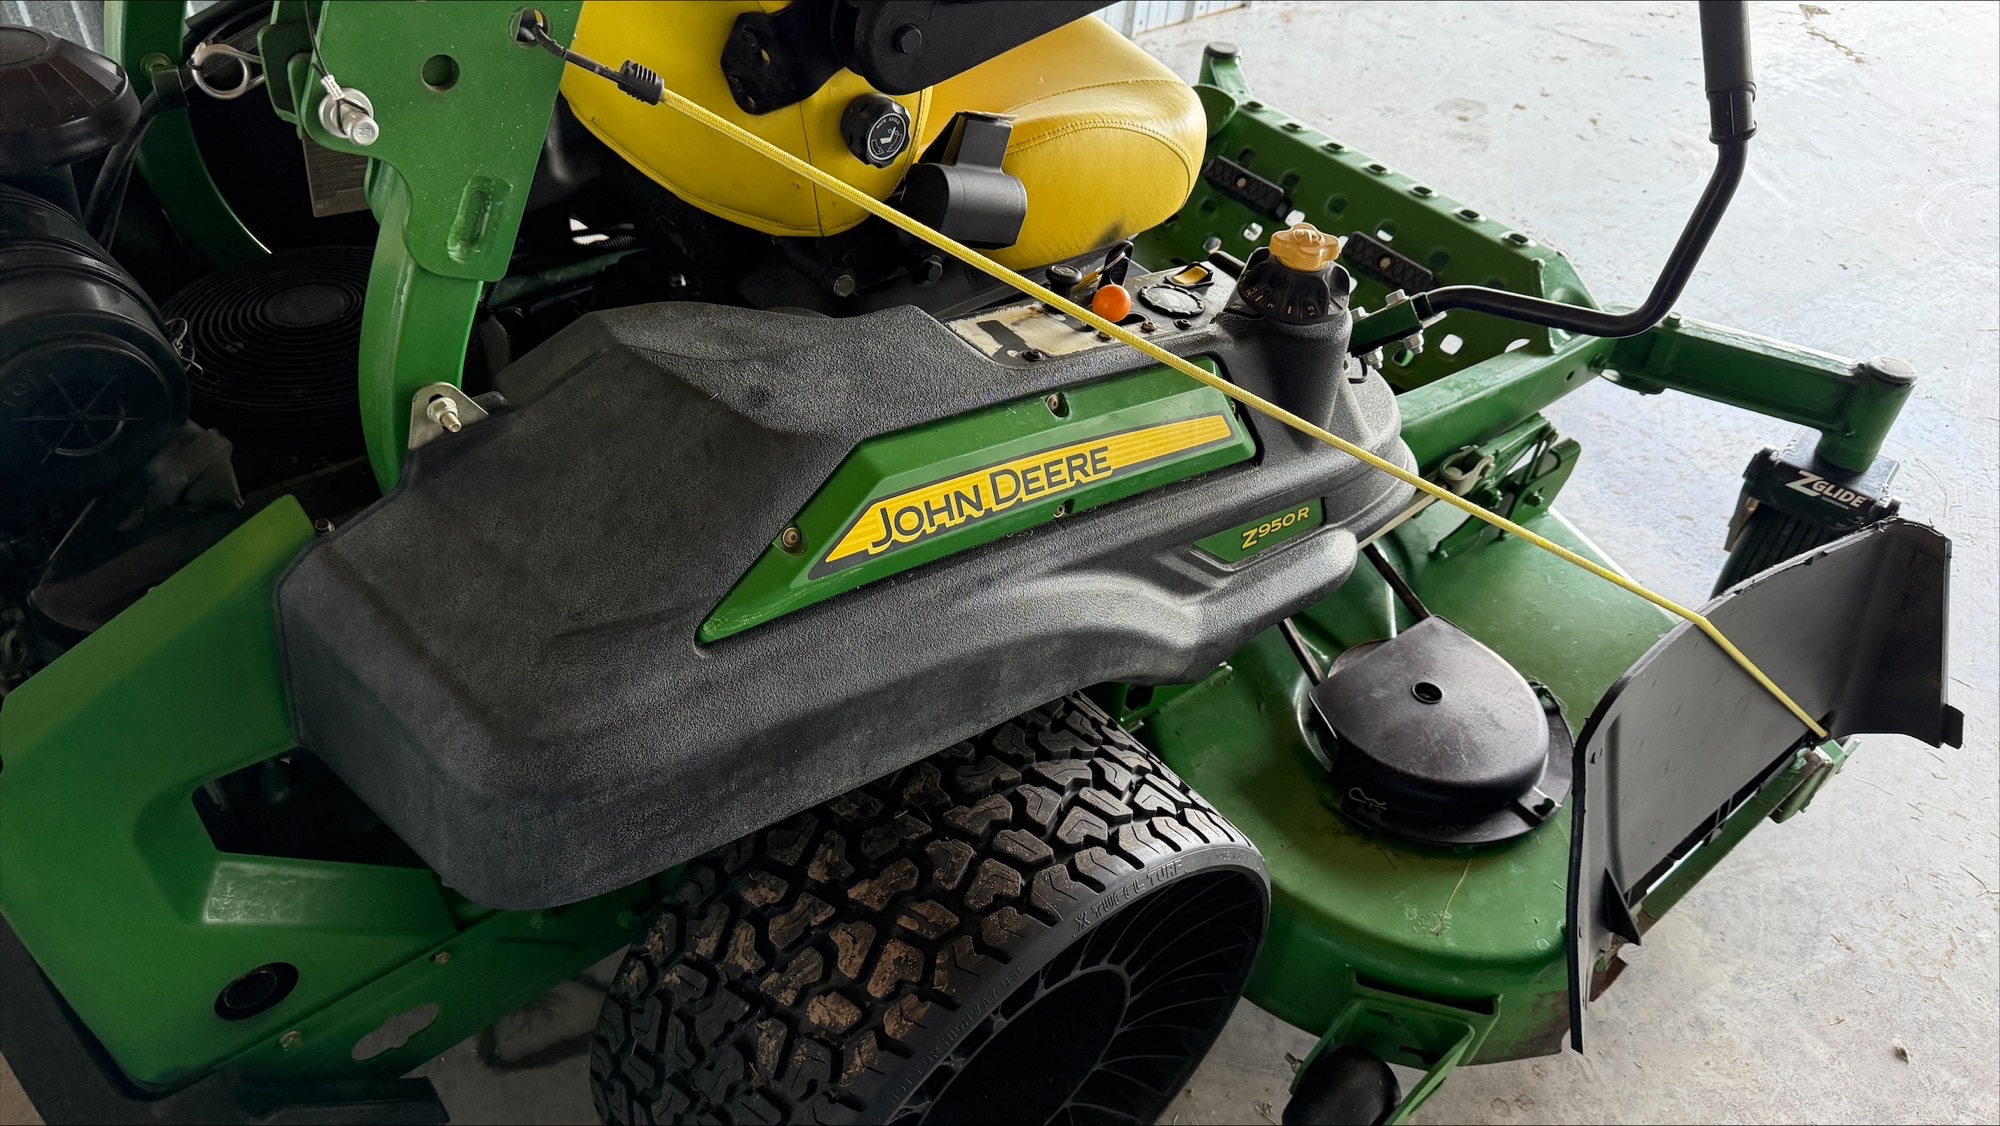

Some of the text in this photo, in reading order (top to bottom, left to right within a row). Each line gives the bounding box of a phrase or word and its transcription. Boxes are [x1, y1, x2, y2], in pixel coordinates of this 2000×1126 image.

[872, 445, 1112, 549] JOHN DEERE
[1091, 879, 1146, 920] TWEEL
[1147, 860, 1184, 887] TURF
[1001, 964, 1028, 989] USE
